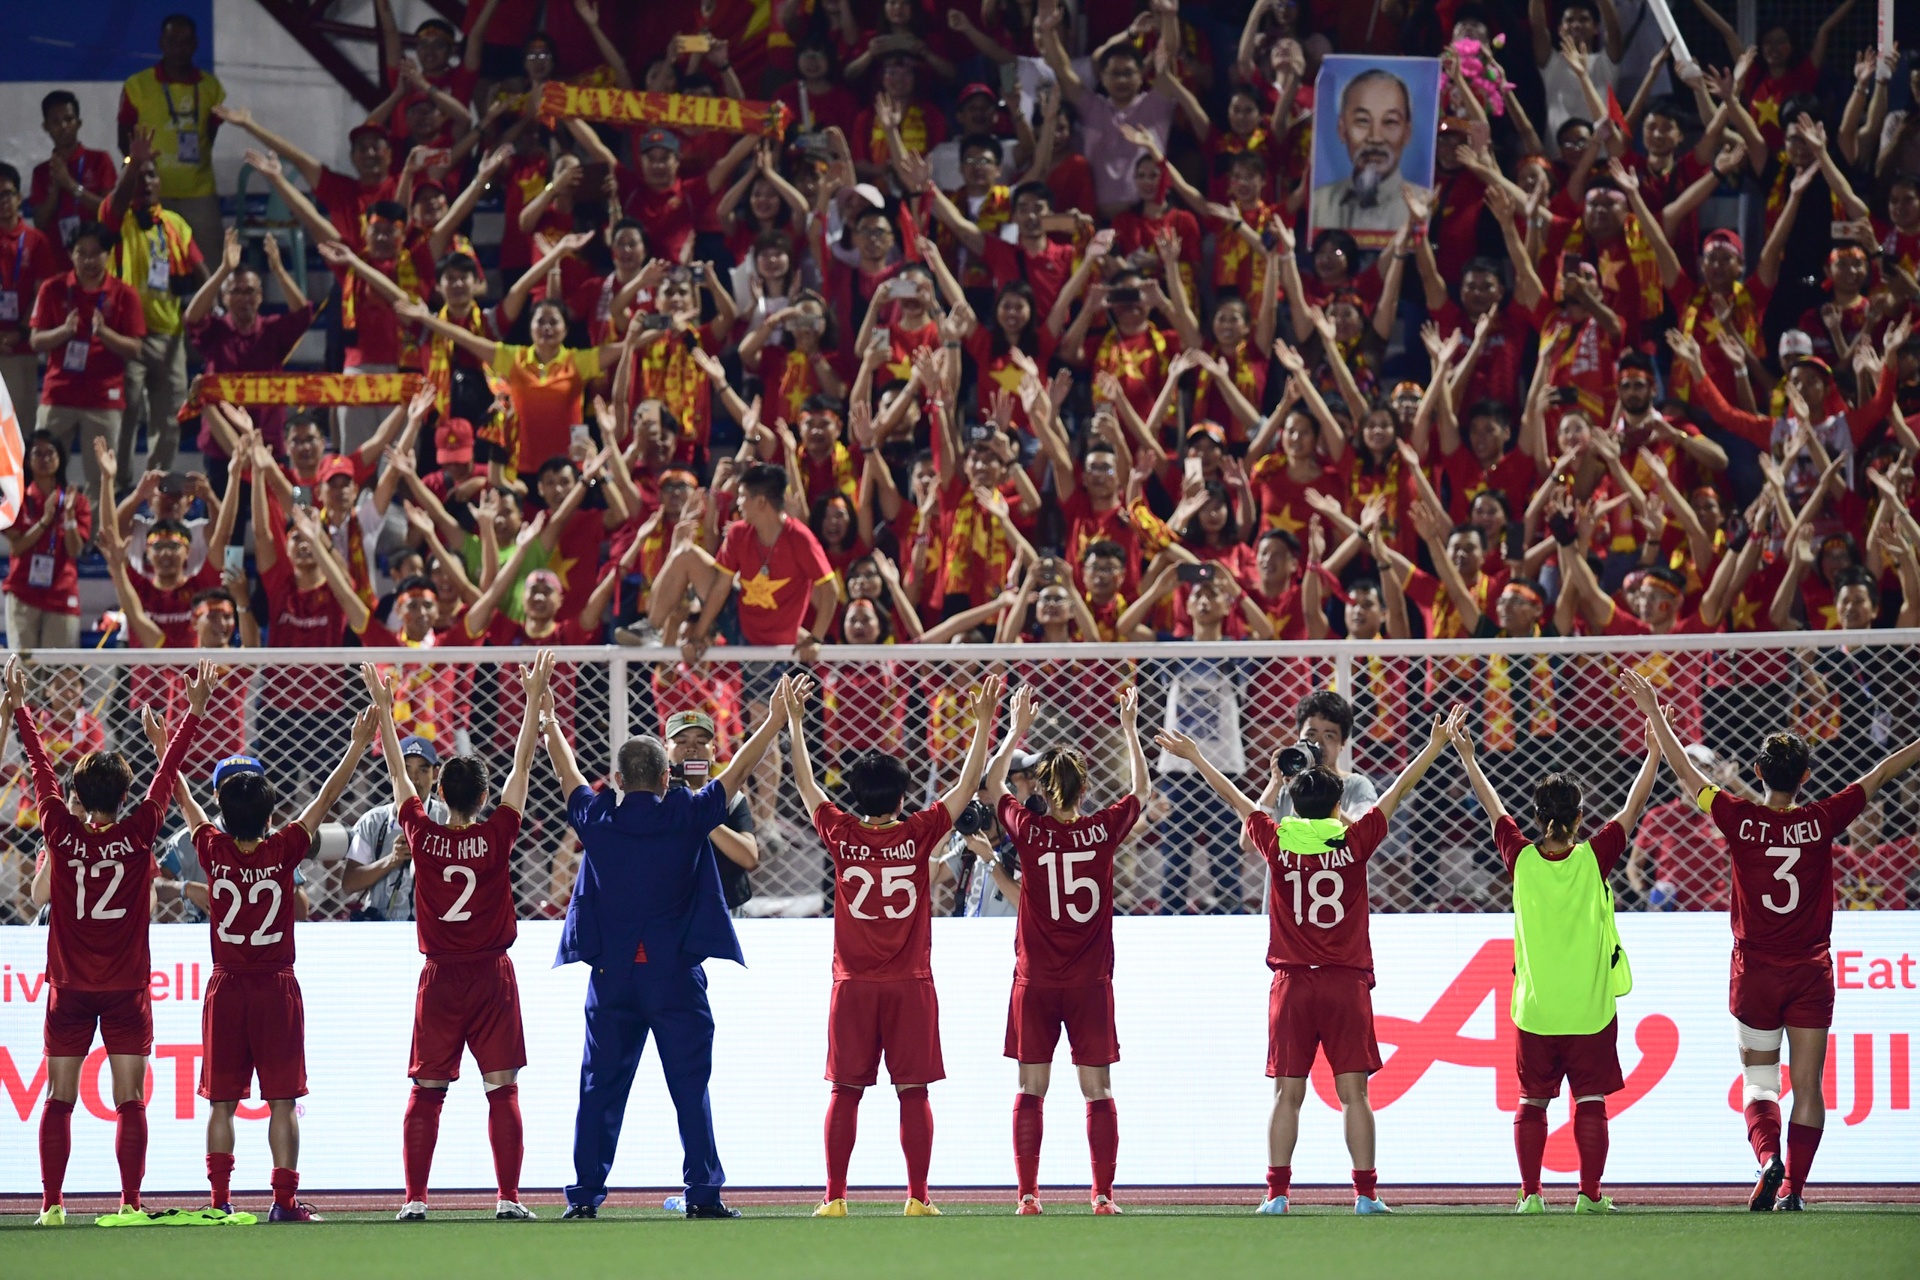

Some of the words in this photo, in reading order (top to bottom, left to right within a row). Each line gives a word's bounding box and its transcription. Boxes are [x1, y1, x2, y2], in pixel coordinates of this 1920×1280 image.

[564, 86, 647, 120] NAM
[660, 93, 743, 129] VIET
[218, 376, 304, 404] VIET
[319, 374, 405, 403] NAM
[880, 838, 916, 861] THAO
[1027, 823, 1060, 848] P.T.
[1068, 822, 1109, 848] TUOI
[1739, 818, 1774, 844] C.T.
[1782, 818, 1822, 845] KIEU
[1318, 845, 1355, 870] VAN
[67, 858, 127, 920] 12
[438, 864, 477, 922] 2
[842, 864, 918, 920] 25
[1037, 850, 1100, 923] 15
[1283, 869, 1345, 929] 18
[1761, 846, 1801, 914] 3
[212, 878, 284, 946] 22
[149, 962, 200, 1002] ell
[1836, 950, 1917, 990] Eat
[0, 1043, 273, 1123] MOT
